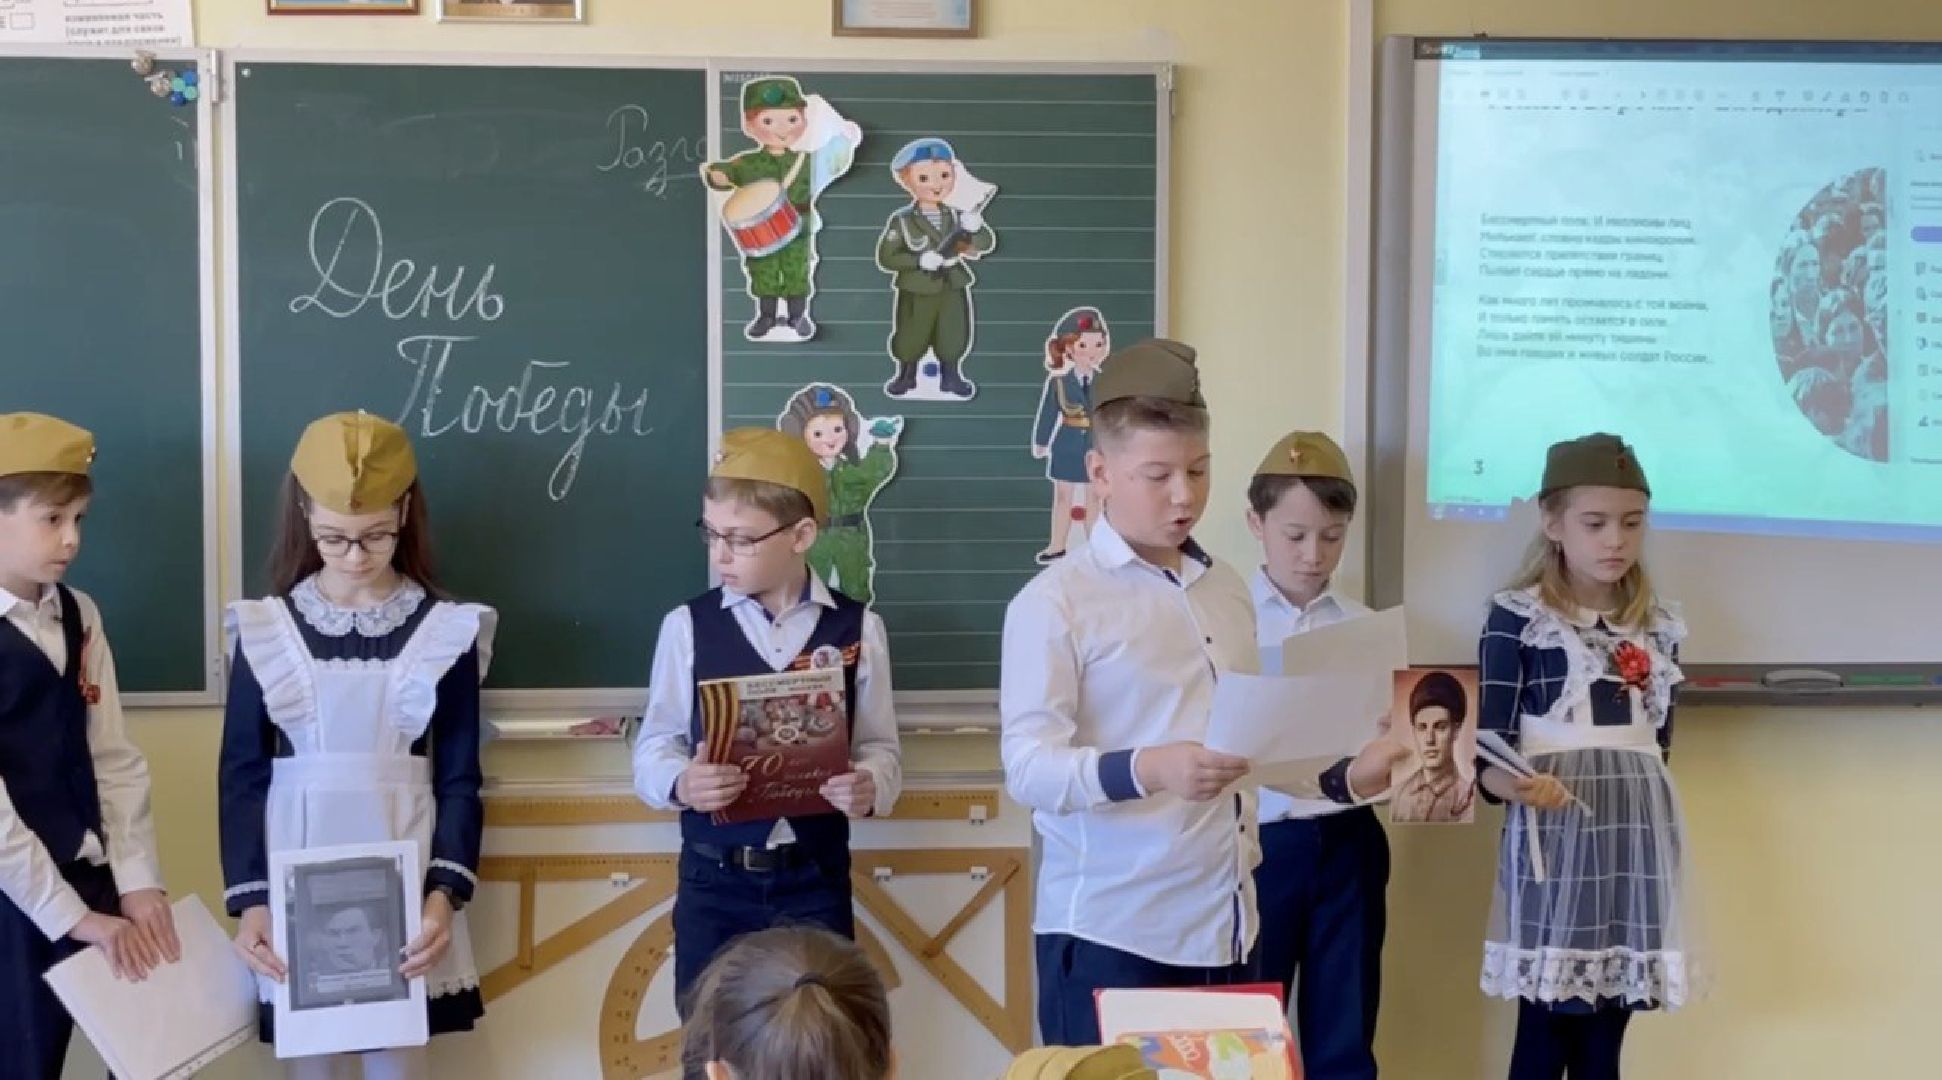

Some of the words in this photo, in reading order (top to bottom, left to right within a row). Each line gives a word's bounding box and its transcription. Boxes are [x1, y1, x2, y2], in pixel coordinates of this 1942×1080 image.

[290, 197, 503, 321] День
[397, 335, 653, 501] Победы
[1473, 459, 1484, 475] 3
[740, 752, 785, 777] 70
